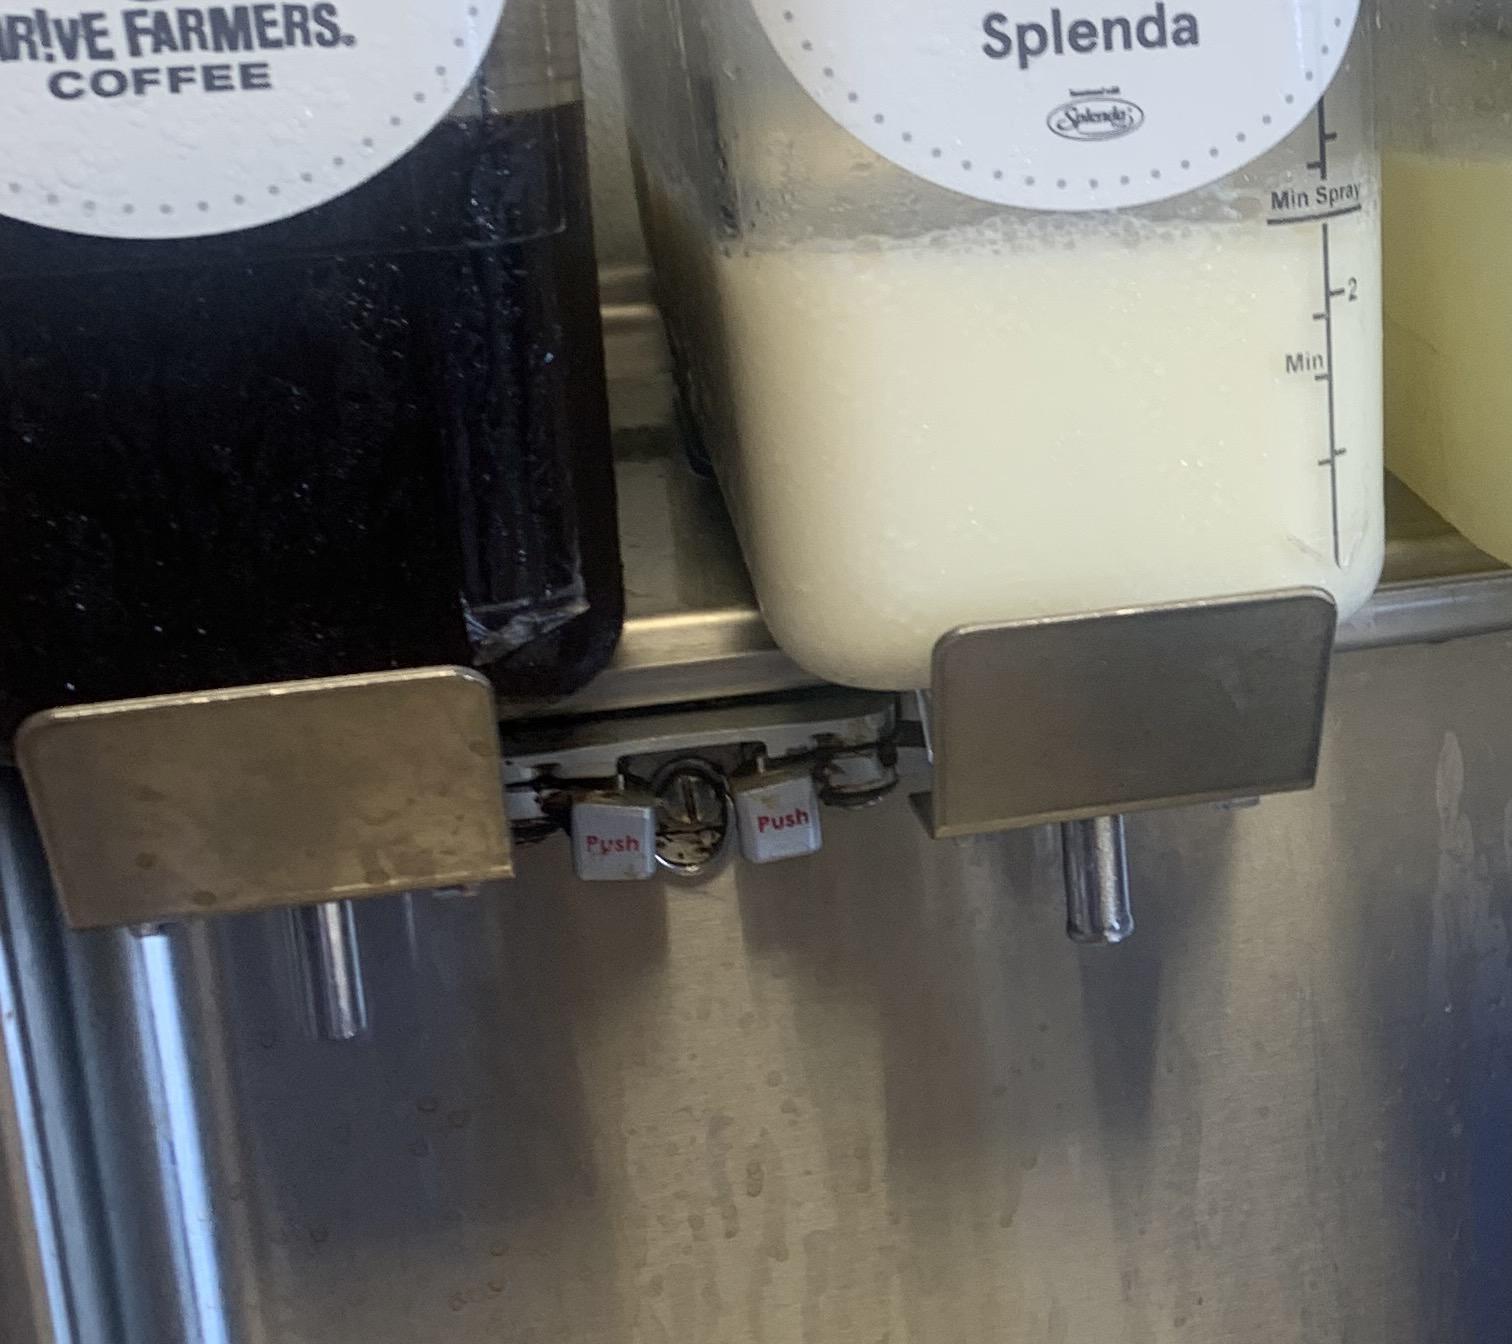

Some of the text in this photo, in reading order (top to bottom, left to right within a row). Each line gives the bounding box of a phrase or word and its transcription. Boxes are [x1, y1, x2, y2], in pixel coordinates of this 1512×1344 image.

[981, 2, 1199, 70] Splenda
[49, 62, 272, 100] COFFEE
[1271, 182, 1361, 211] Min Spray
[1347, 277, 1358, 302] 2
[1285, 351, 1324, 374] Min
[757, 807, 810, 834] Push
[586, 835, 640, 854] Push
